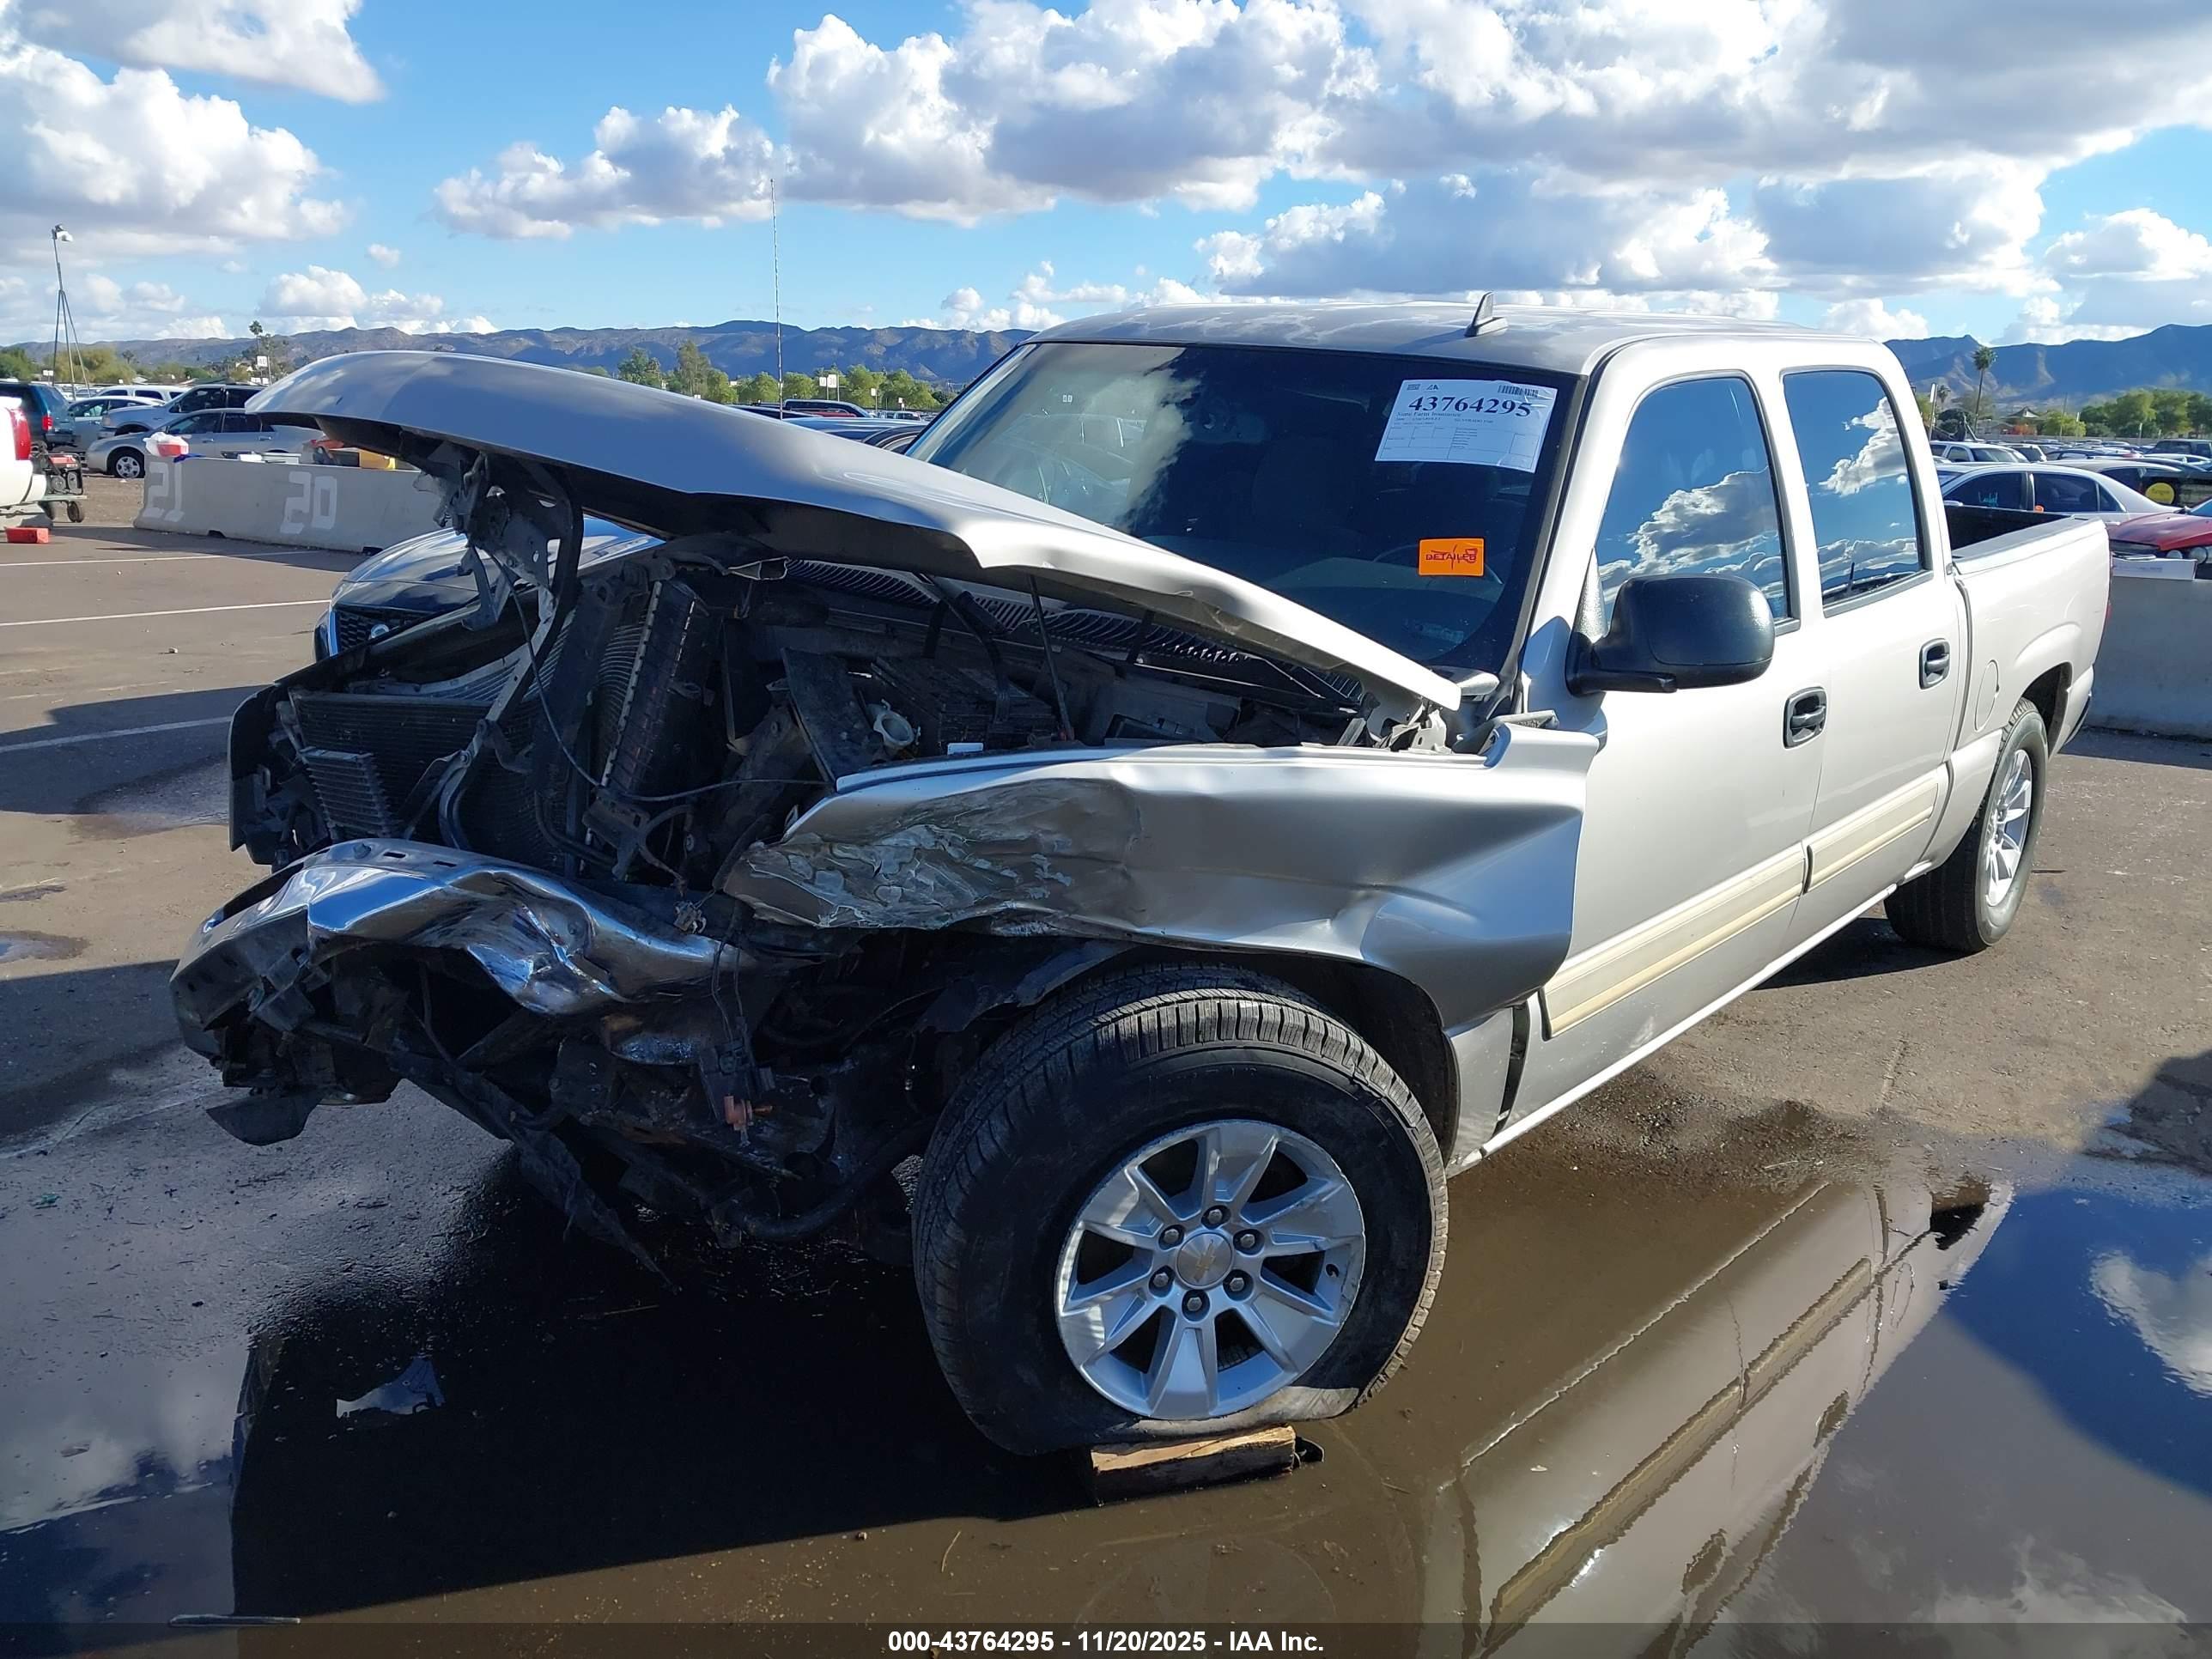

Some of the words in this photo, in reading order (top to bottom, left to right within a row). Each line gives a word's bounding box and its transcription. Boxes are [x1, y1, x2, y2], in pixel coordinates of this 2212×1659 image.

[1408, 396, 1533, 417] 43764295
[142, 462, 185, 522] 21
[279, 471, 337, 534] 20
